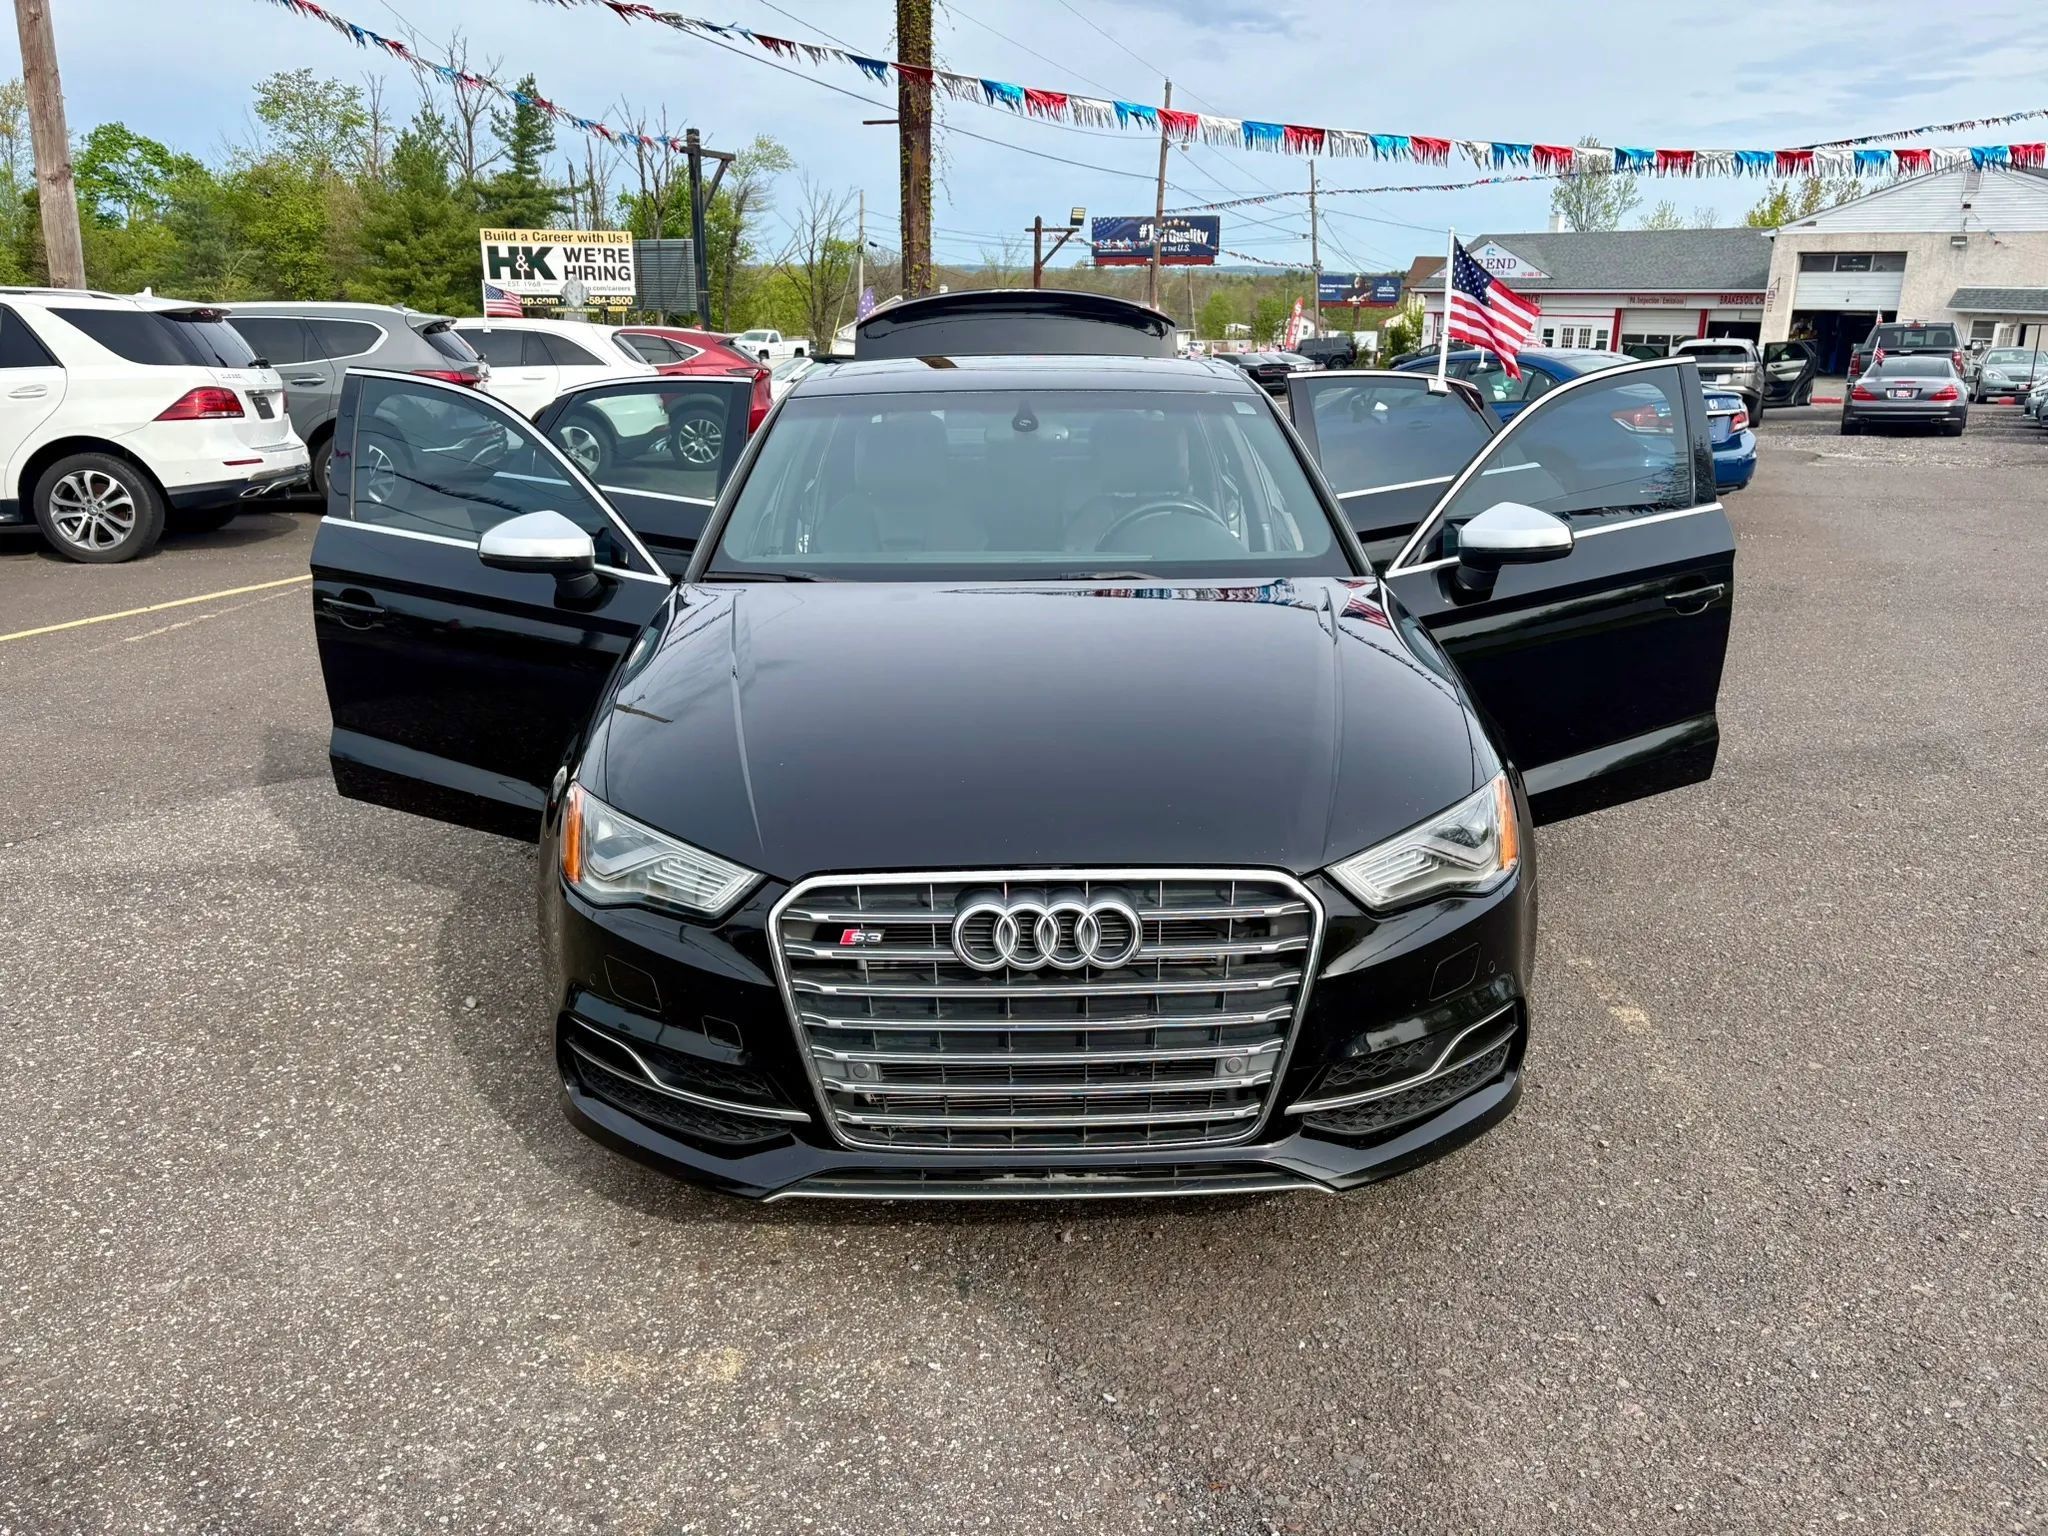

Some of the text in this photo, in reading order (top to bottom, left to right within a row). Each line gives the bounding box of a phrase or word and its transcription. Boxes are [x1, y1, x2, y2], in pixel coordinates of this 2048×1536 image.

[484, 231, 516, 241] Build
[520, 233, 528, 241] a
[532, 232, 573, 243] Career
[577, 233, 604, 243] with
[1169, 228, 1209, 244] Quality
[487, 245, 557, 280] H&K
[563, 247, 631, 264] WE'RE
[564, 265, 632, 281] HIRING
[852, 932, 881, 943] S3
